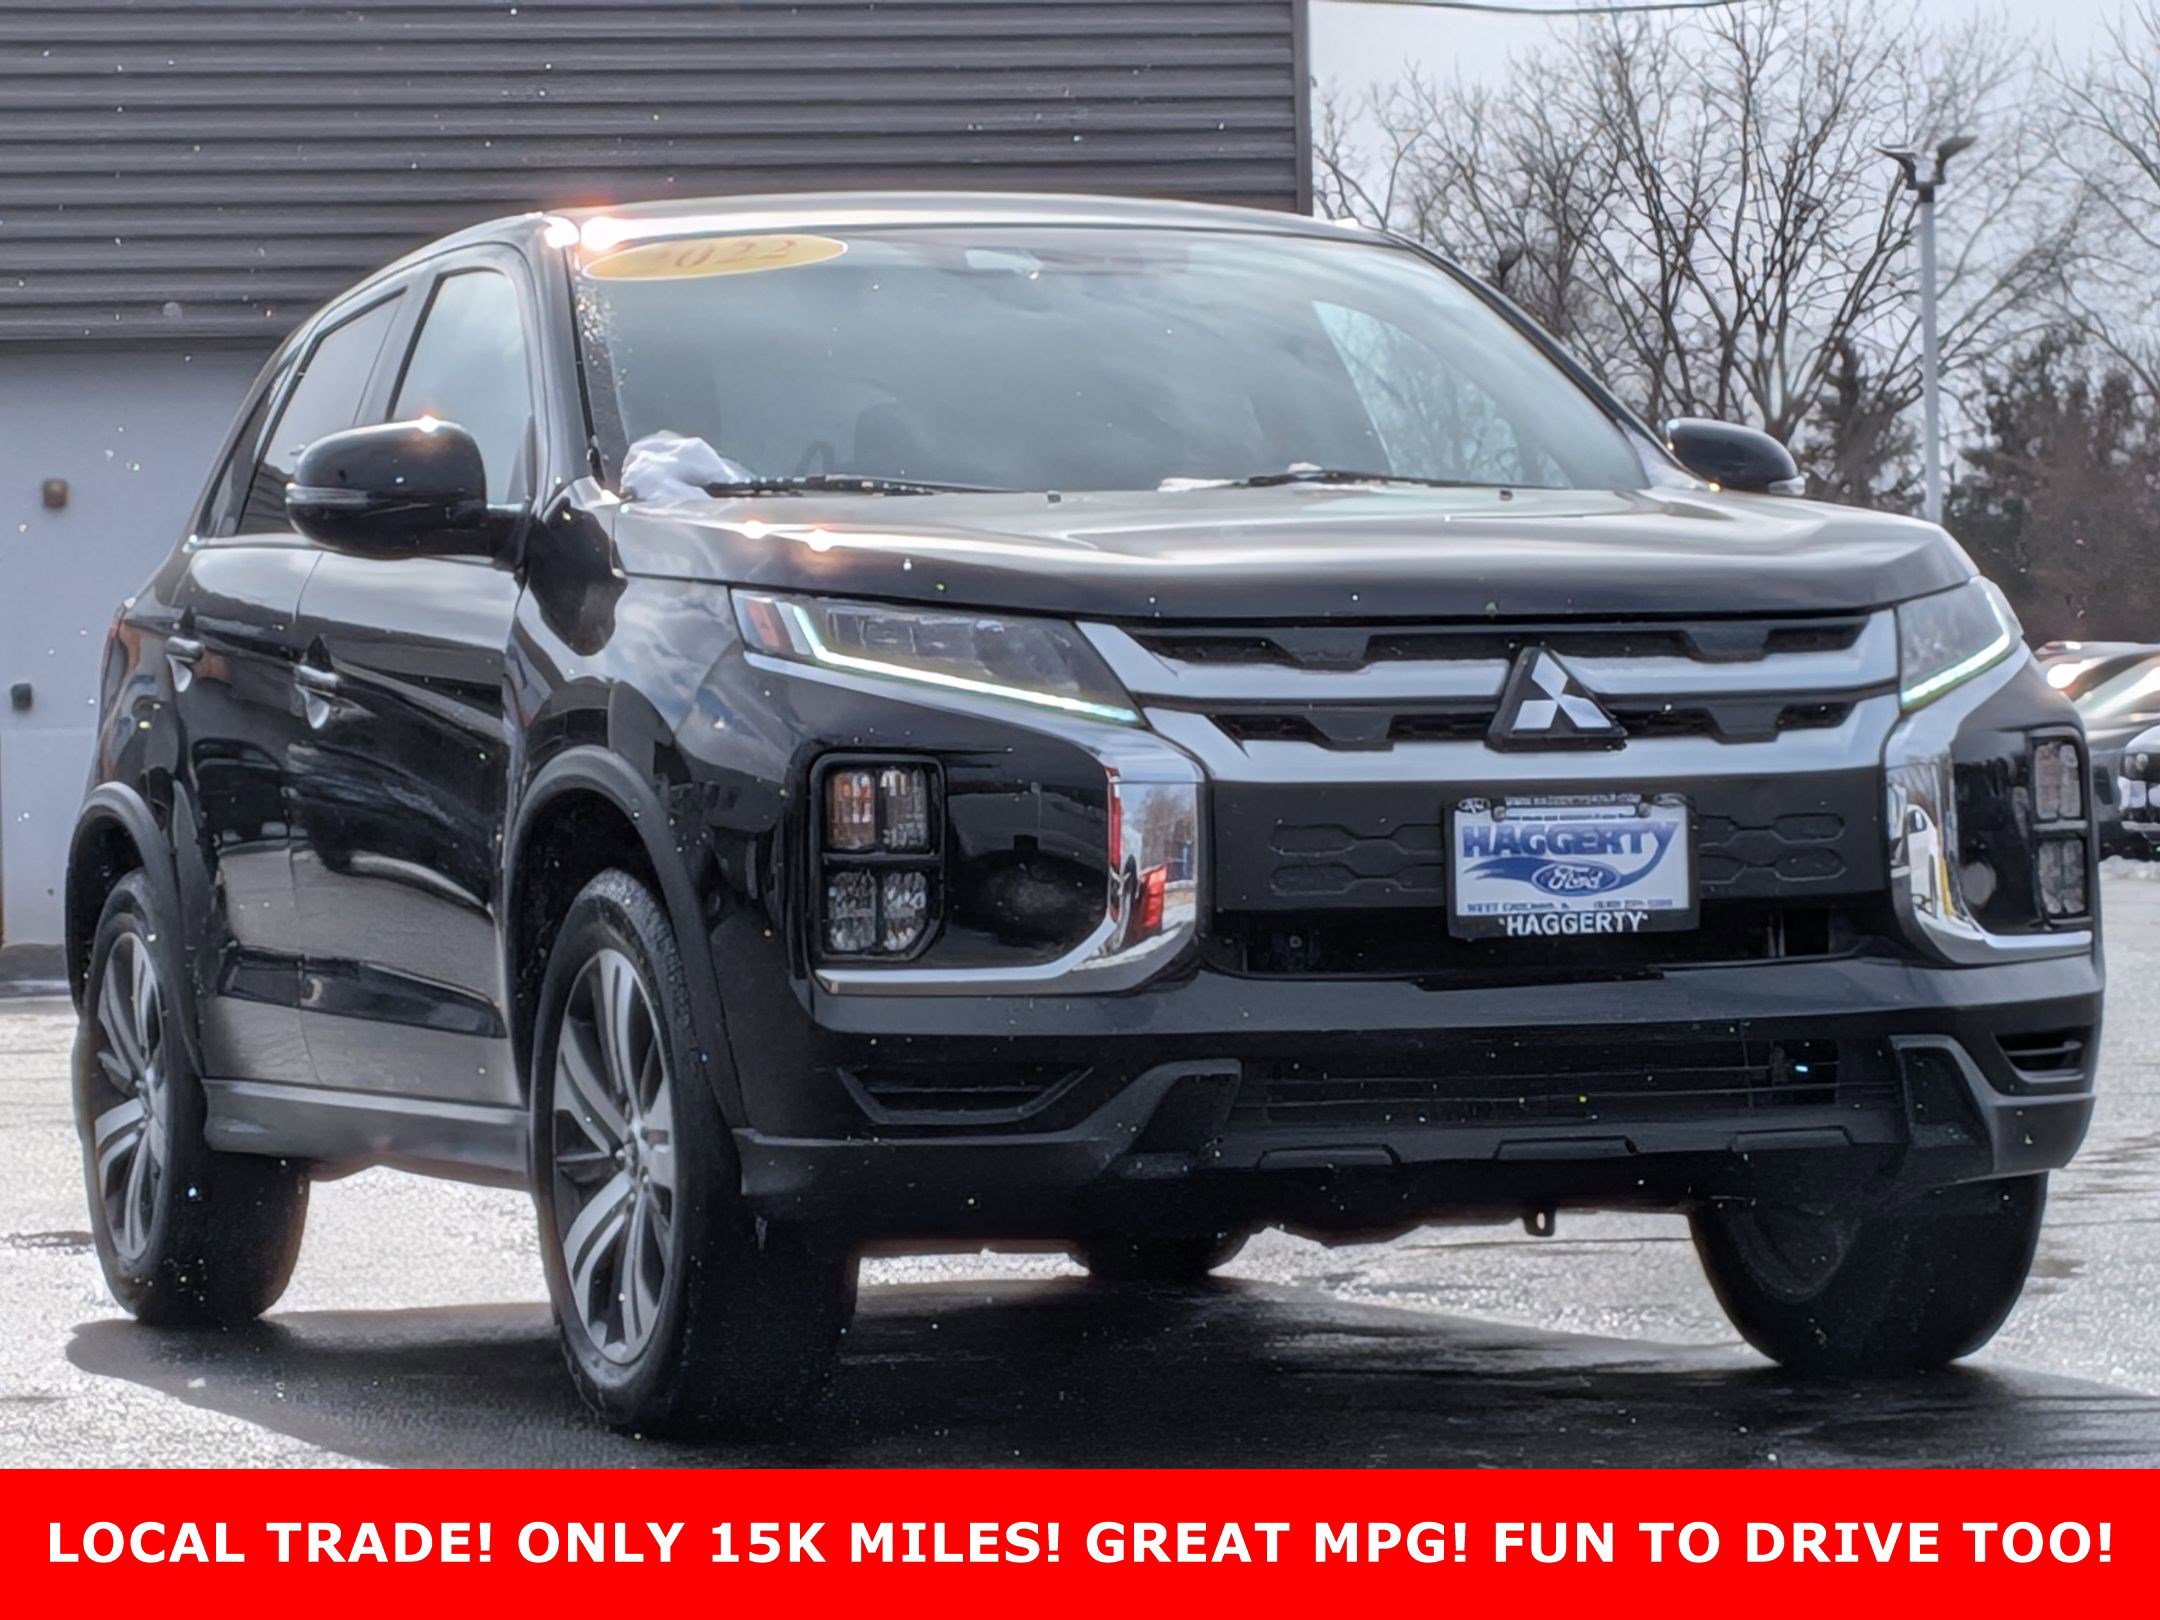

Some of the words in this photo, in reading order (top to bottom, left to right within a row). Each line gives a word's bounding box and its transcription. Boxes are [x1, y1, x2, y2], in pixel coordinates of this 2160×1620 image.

[1462, 821, 1679, 858] HAGGERTY
[1549, 866, 1604, 890] Ford
[1506, 911, 1642, 937] HAGGERTY
